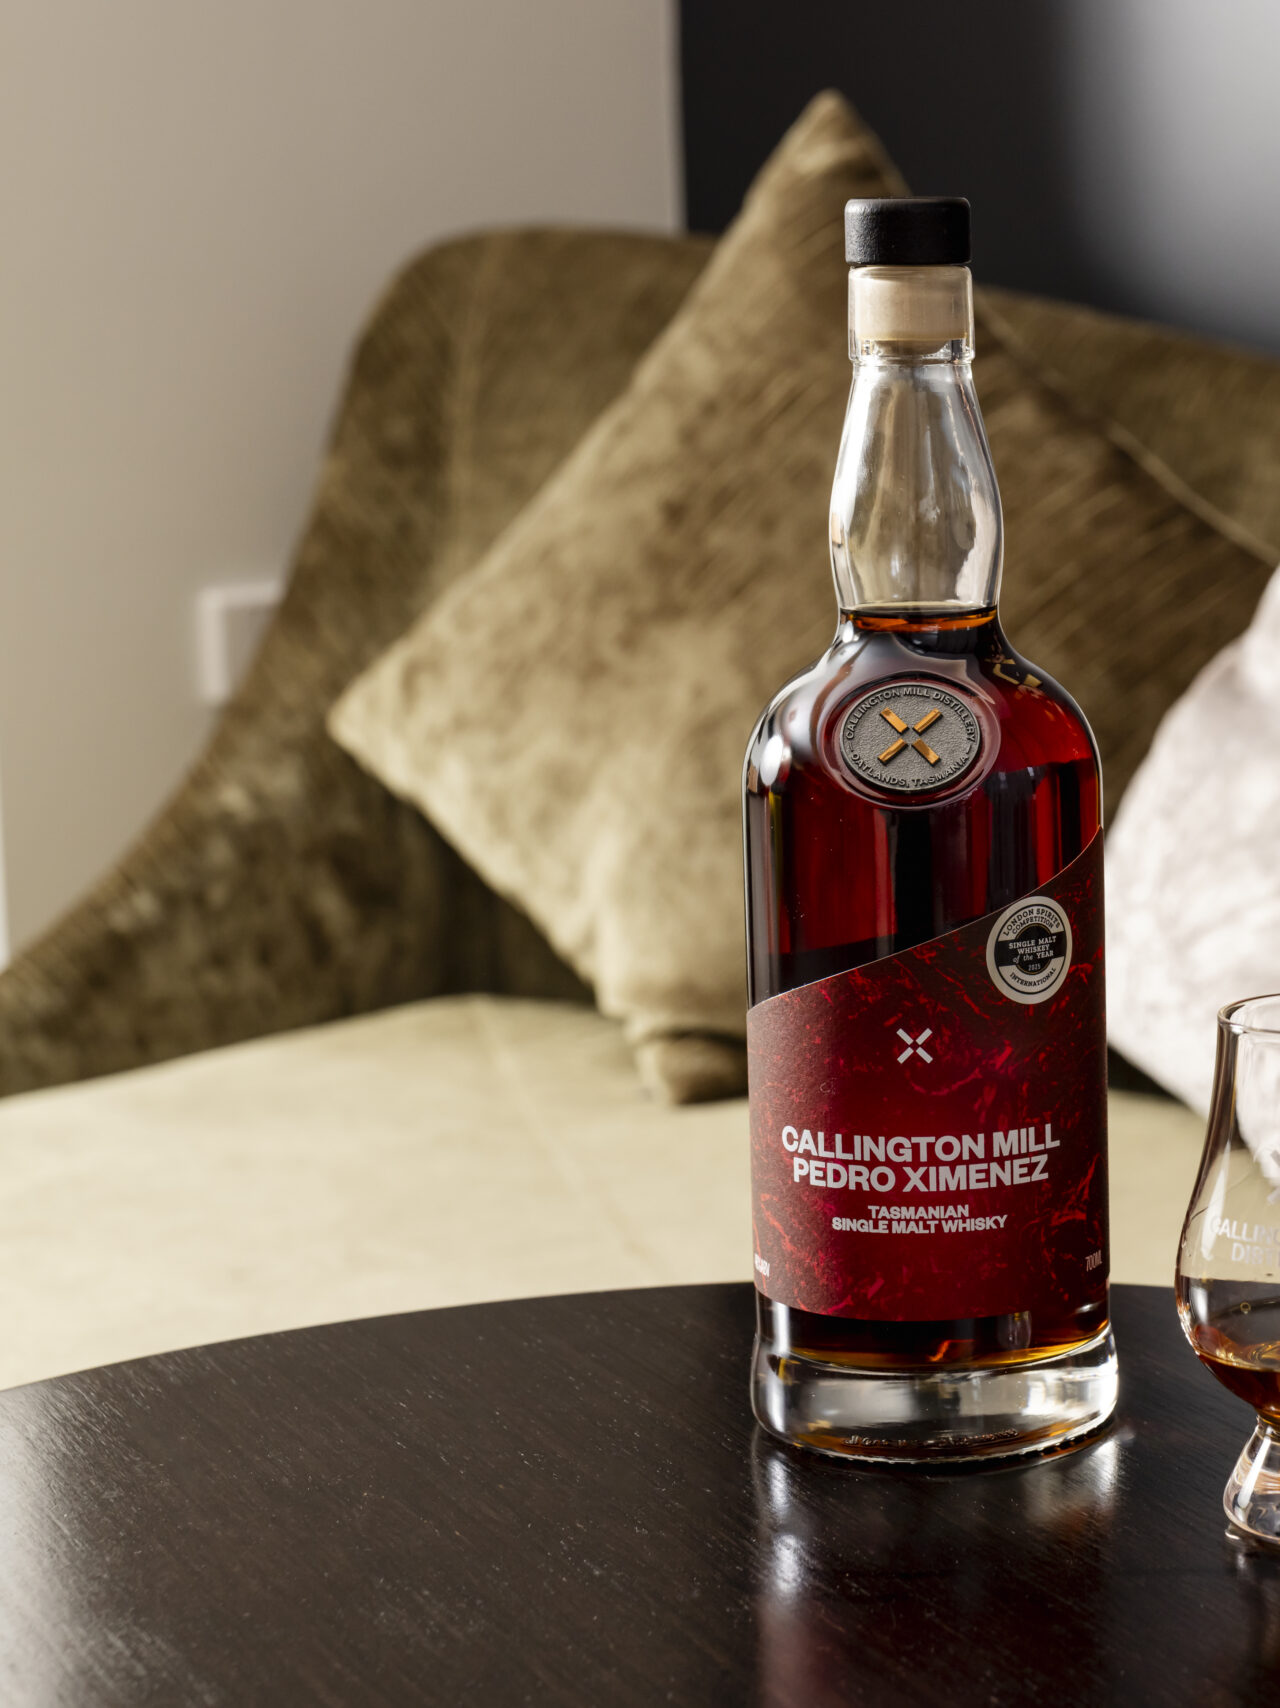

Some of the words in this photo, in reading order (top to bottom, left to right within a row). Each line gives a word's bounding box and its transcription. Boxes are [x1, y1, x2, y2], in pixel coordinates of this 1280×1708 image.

[846, 690, 901, 740] CALLINGTON
[903, 687, 930, 698] MILL
[932, 691, 976, 743] DISTILLERY
[912, 755, 969, 787] TASMANIA
[1003, 908, 1034, 936] LONDON
[1036, 908, 1061, 929] SPIRITS
[1012, 916, 1055, 935] COMPETITION
[1008, 940, 1036, 949] SINGLE
[1039, 936, 1057, 945] MALT
[1017, 944, 1050, 954] WHISKEY
[1036, 950, 1054, 959] YEAR
[1010, 967, 1056, 987] INTERNATIONAL
[781, 1125, 985, 1163] CALLINGTON
[992, 1123, 1060, 1157] MILL
[793, 1157, 896, 1192] PEDRO
[902, 1154, 1049, 1193] XIMENEZ
[868, 1204, 969, 1220] TASMANIAN
[832, 1217, 889, 1234] SINGLE
[892, 1218, 936, 1234] MALT
[942, 1215, 1008, 1233] WHISKY
